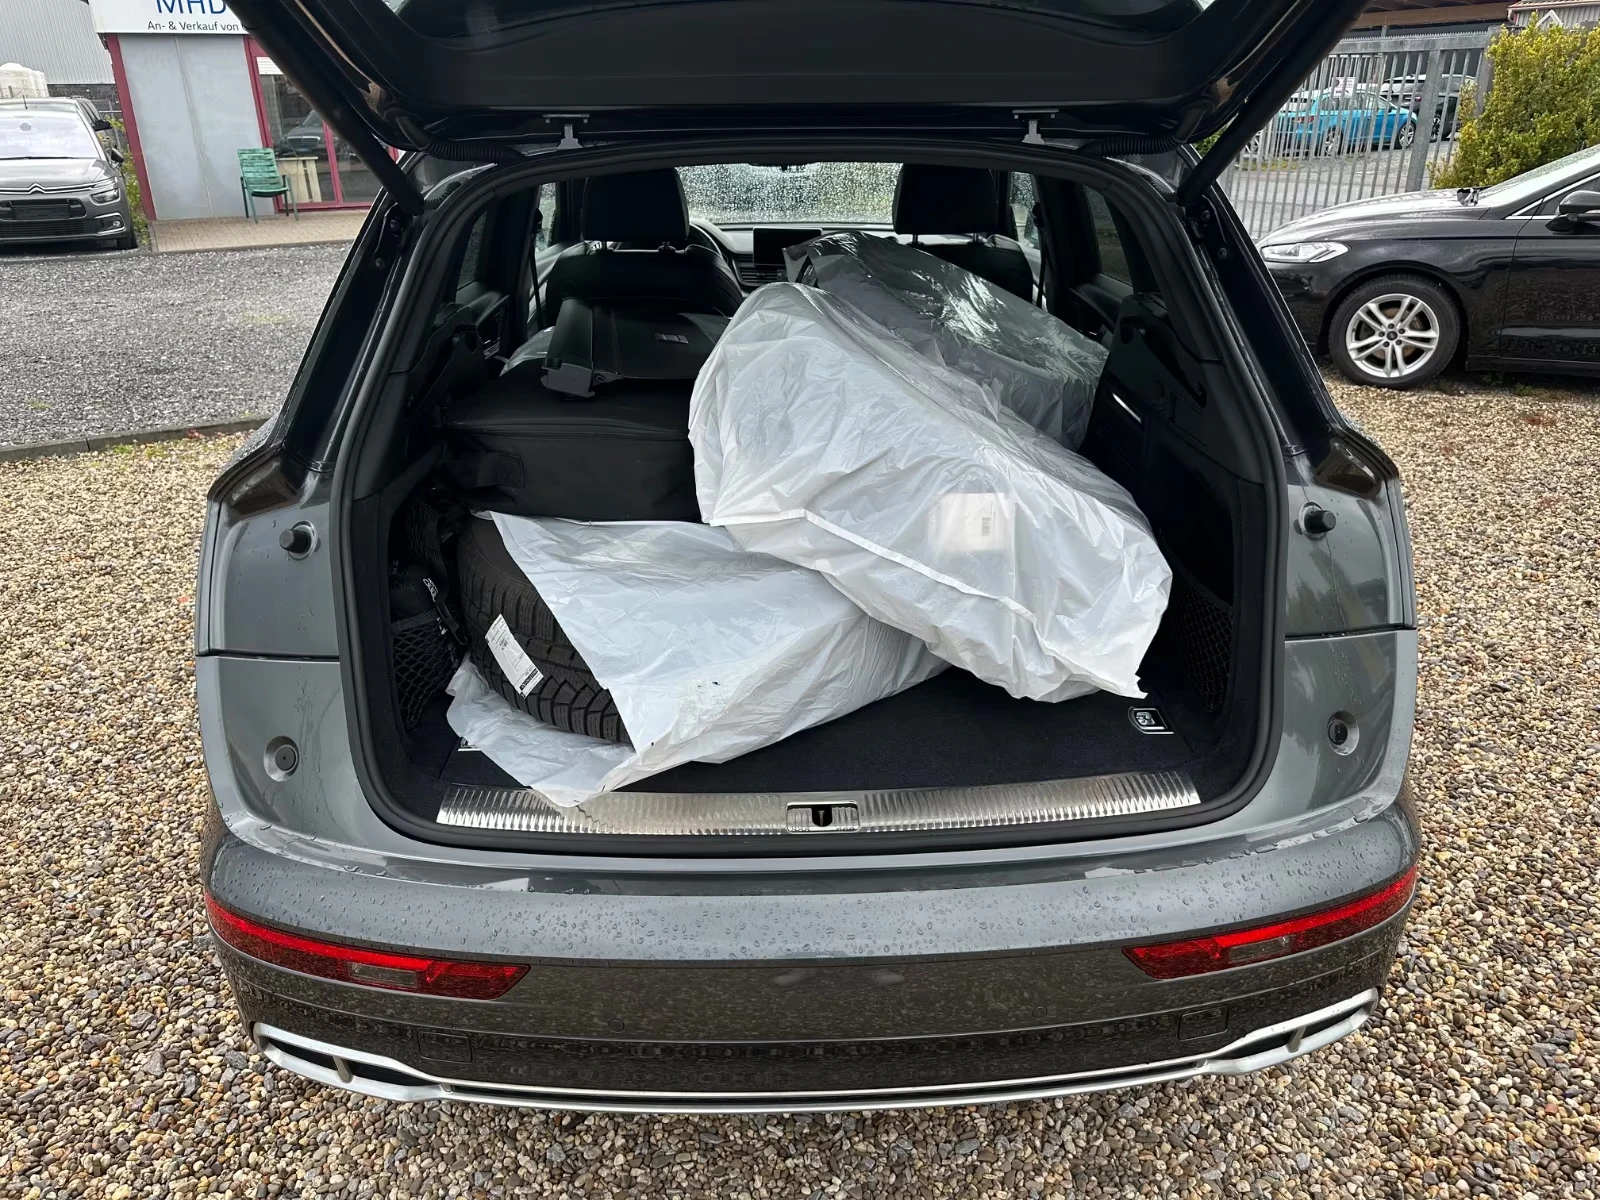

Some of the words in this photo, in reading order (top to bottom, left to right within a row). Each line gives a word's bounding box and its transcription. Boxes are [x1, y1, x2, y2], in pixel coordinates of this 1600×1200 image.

[147, 20, 166, 31] An-
[168, 20, 177, 31] &
[179, 21, 218, 31] Verkauf
[220, 23, 239, 31] von
